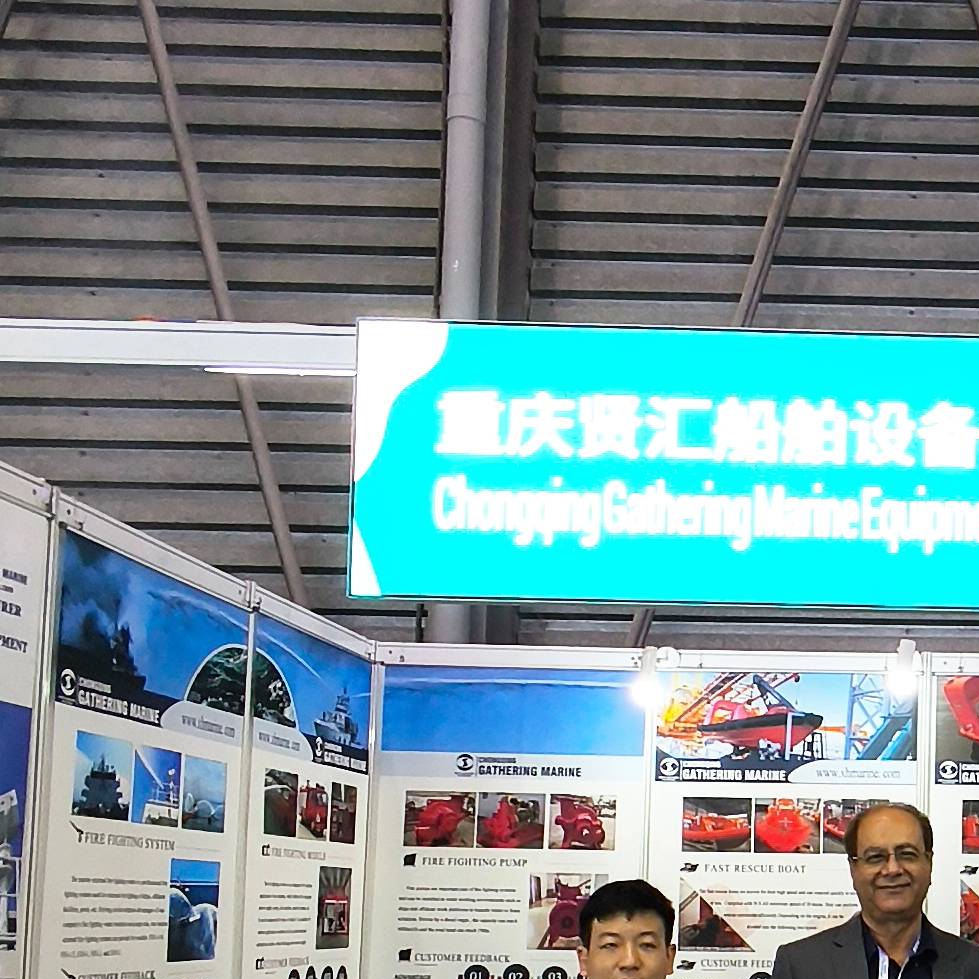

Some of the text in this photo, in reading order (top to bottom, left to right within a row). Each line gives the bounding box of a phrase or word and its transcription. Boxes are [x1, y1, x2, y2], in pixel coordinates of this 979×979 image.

[432, 474, 602, 548] Chongqing
[602, 478, 752, 552] Gathering
[753, 481, 860, 541] Marine
[78, 689, 128, 716] GATHERING
[478, 765, 582, 777] GATHERING MARINE
[682, 769, 786, 782] GATHERING MARINE
[84, 831, 105, 845] FIRE
[145, 838, 175, 851] SYSTEM
[422, 856, 528, 868] FIRE FIGHTING PUMP
[704, 864, 807, 874] FAST RESCUE BOAT
[414, 952, 511, 963] CUSTOMER FEEDBACK
[700, 959, 773, 969] CUSTOMER FEED
